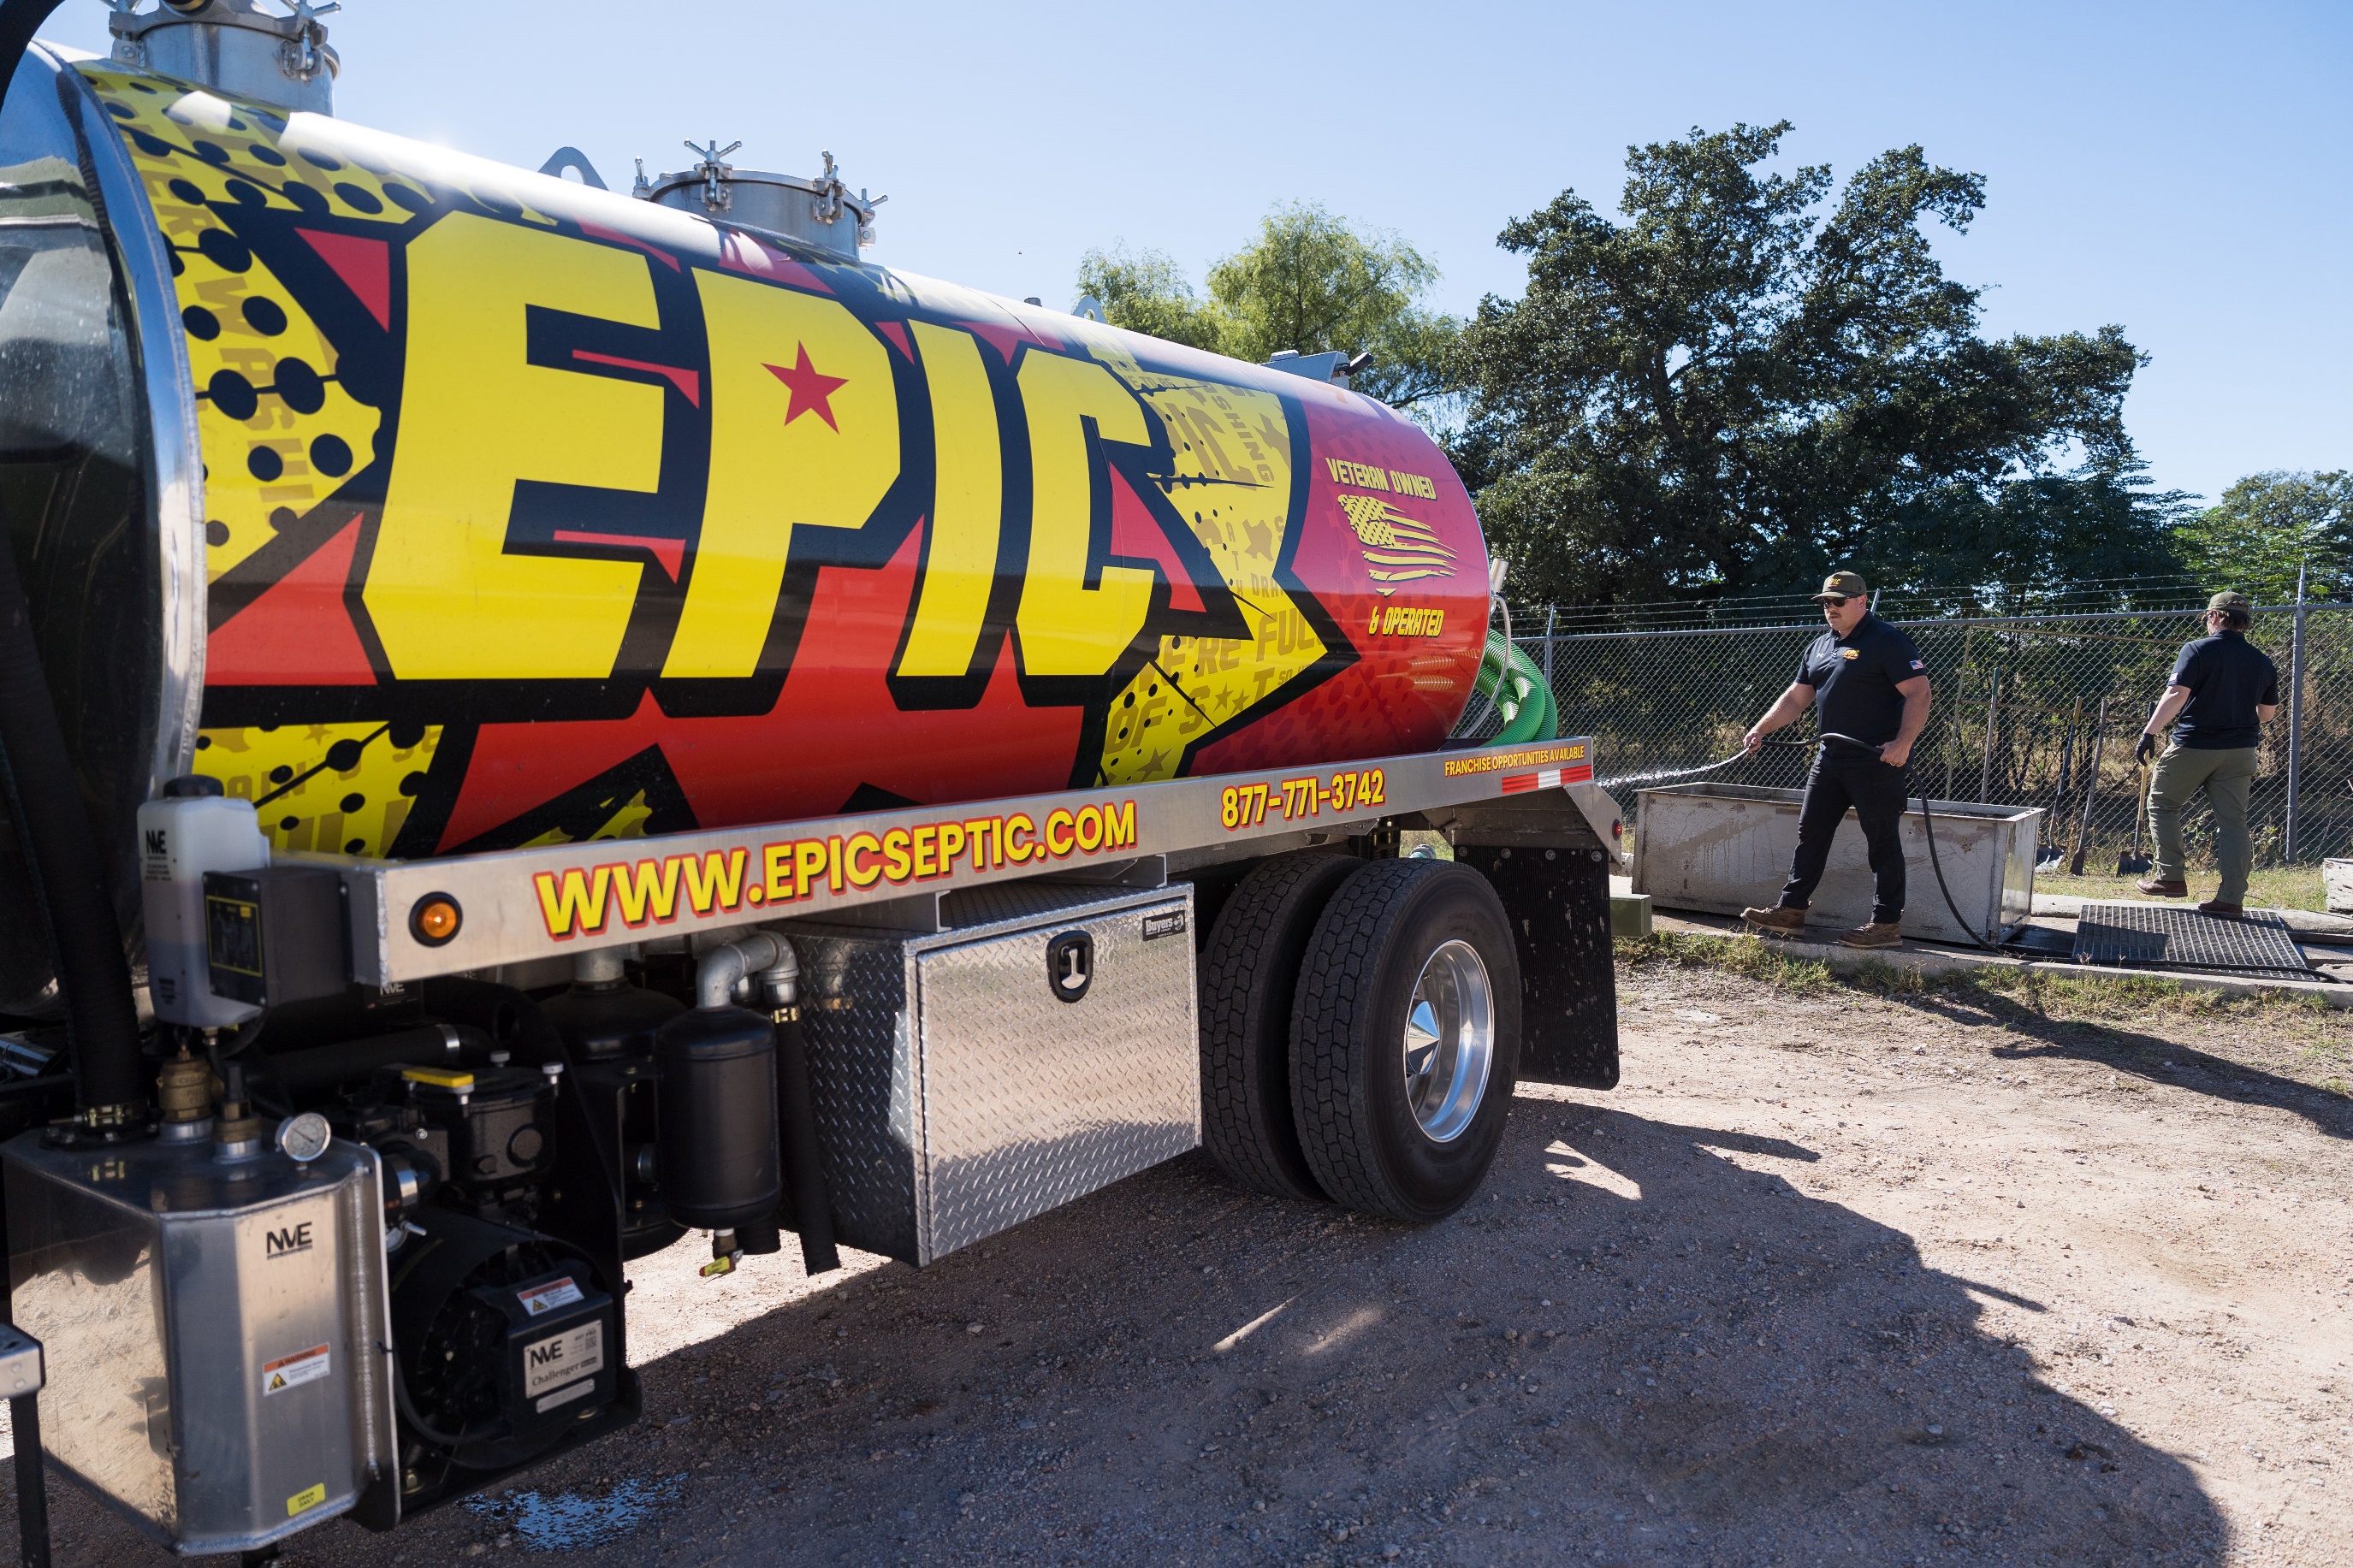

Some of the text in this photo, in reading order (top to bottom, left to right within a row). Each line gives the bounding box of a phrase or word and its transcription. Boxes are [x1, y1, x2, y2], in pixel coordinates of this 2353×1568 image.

[362, 209, 1157, 681] EPIC
[1325, 458, 1438, 500] VETERAN OWNED
[1250, 572, 1283, 598] DRA
[1255, 607, 1322, 662] FUL
[1369, 606, 1445, 637] & OPERATED
[1444, 745, 1585, 777] FRANCHISE OPPORTUNITIES AVAILABLE
[1222, 768, 1384, 829] 877-771-3742
[535, 800, 1137, 938] WWW.EPICSEPTIC.COM
[1146, 917, 1173, 932] Buyers
[266, 1222, 312, 1254] NVE
[530, 1340, 563, 1370] NVE
[532, 1362, 580, 1388] Challenger
